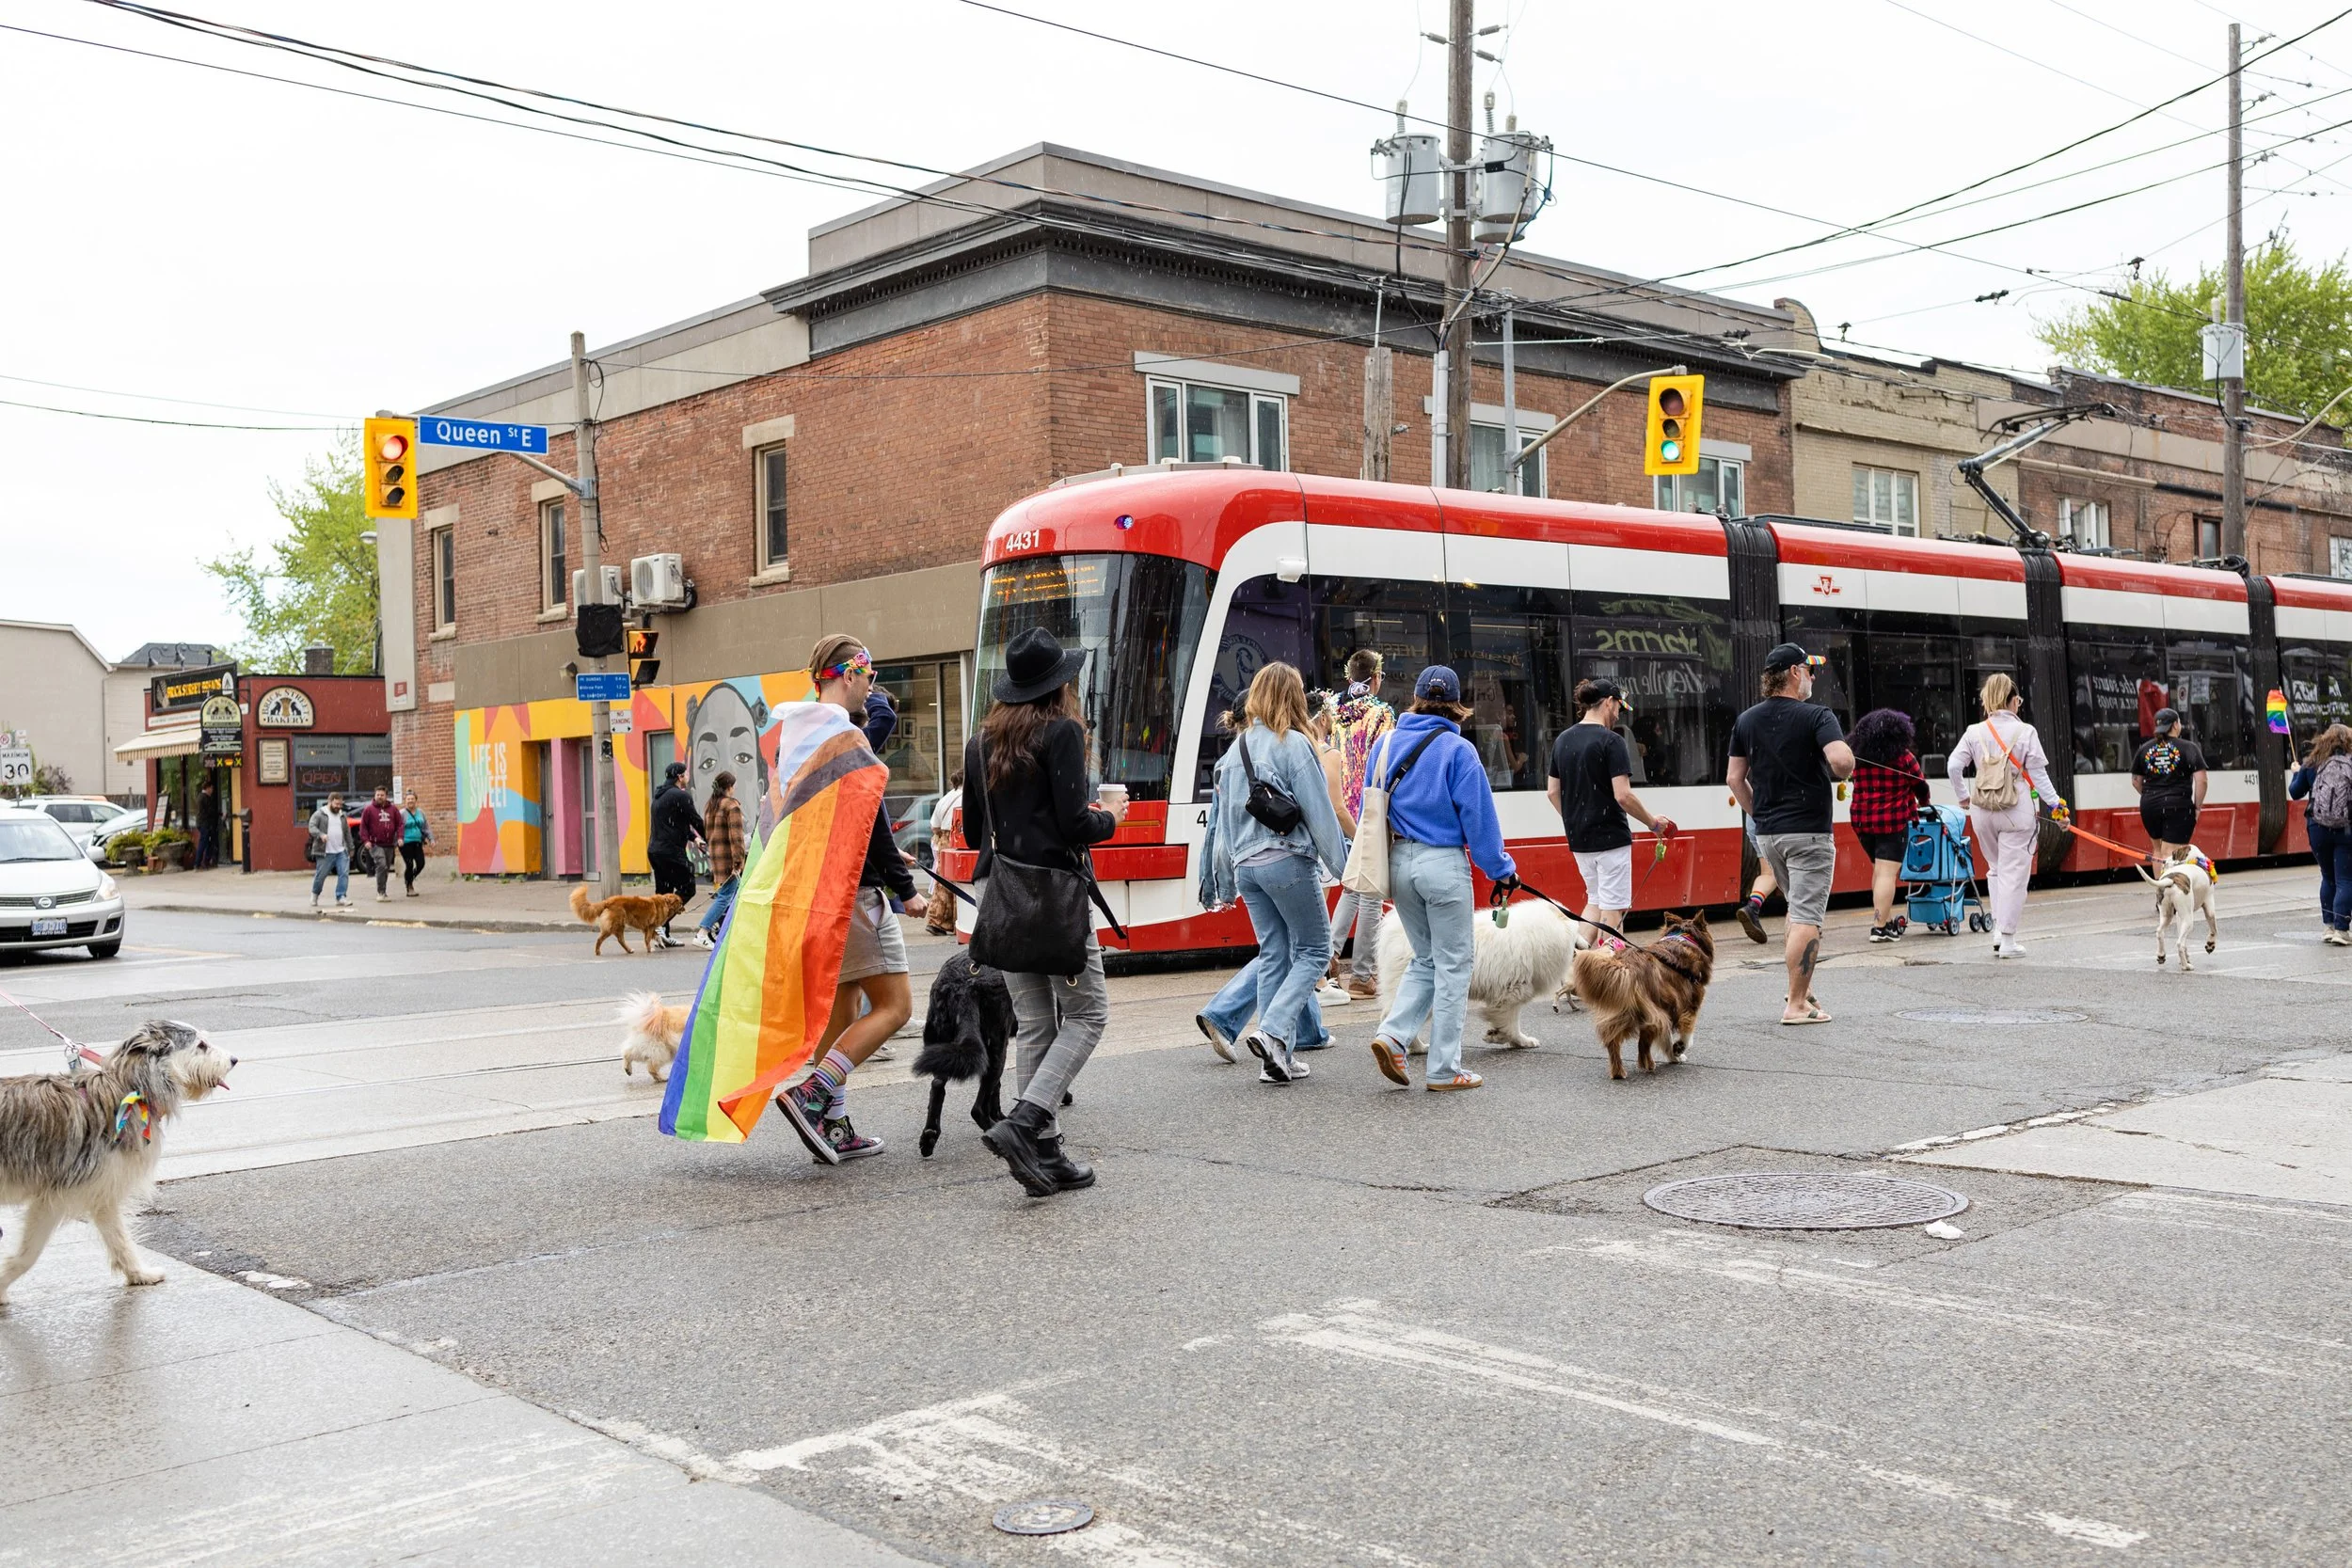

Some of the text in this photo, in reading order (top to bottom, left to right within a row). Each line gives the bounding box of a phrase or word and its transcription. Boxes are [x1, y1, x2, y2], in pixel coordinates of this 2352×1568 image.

[437, 420, 532, 447] Queen St E
[1006, 529, 1041, 552] 4431
[262, 689, 310, 716] BRICK STREET
[266, 716, 306, 724] BAKERY
[469, 741, 507, 777] LIFE IS
[5, 763, 29, 780] 30
[301, 771, 342, 784] OPEN
[2244, 774, 2259, 785] 4431
[469, 775, 507, 810] SWEET
